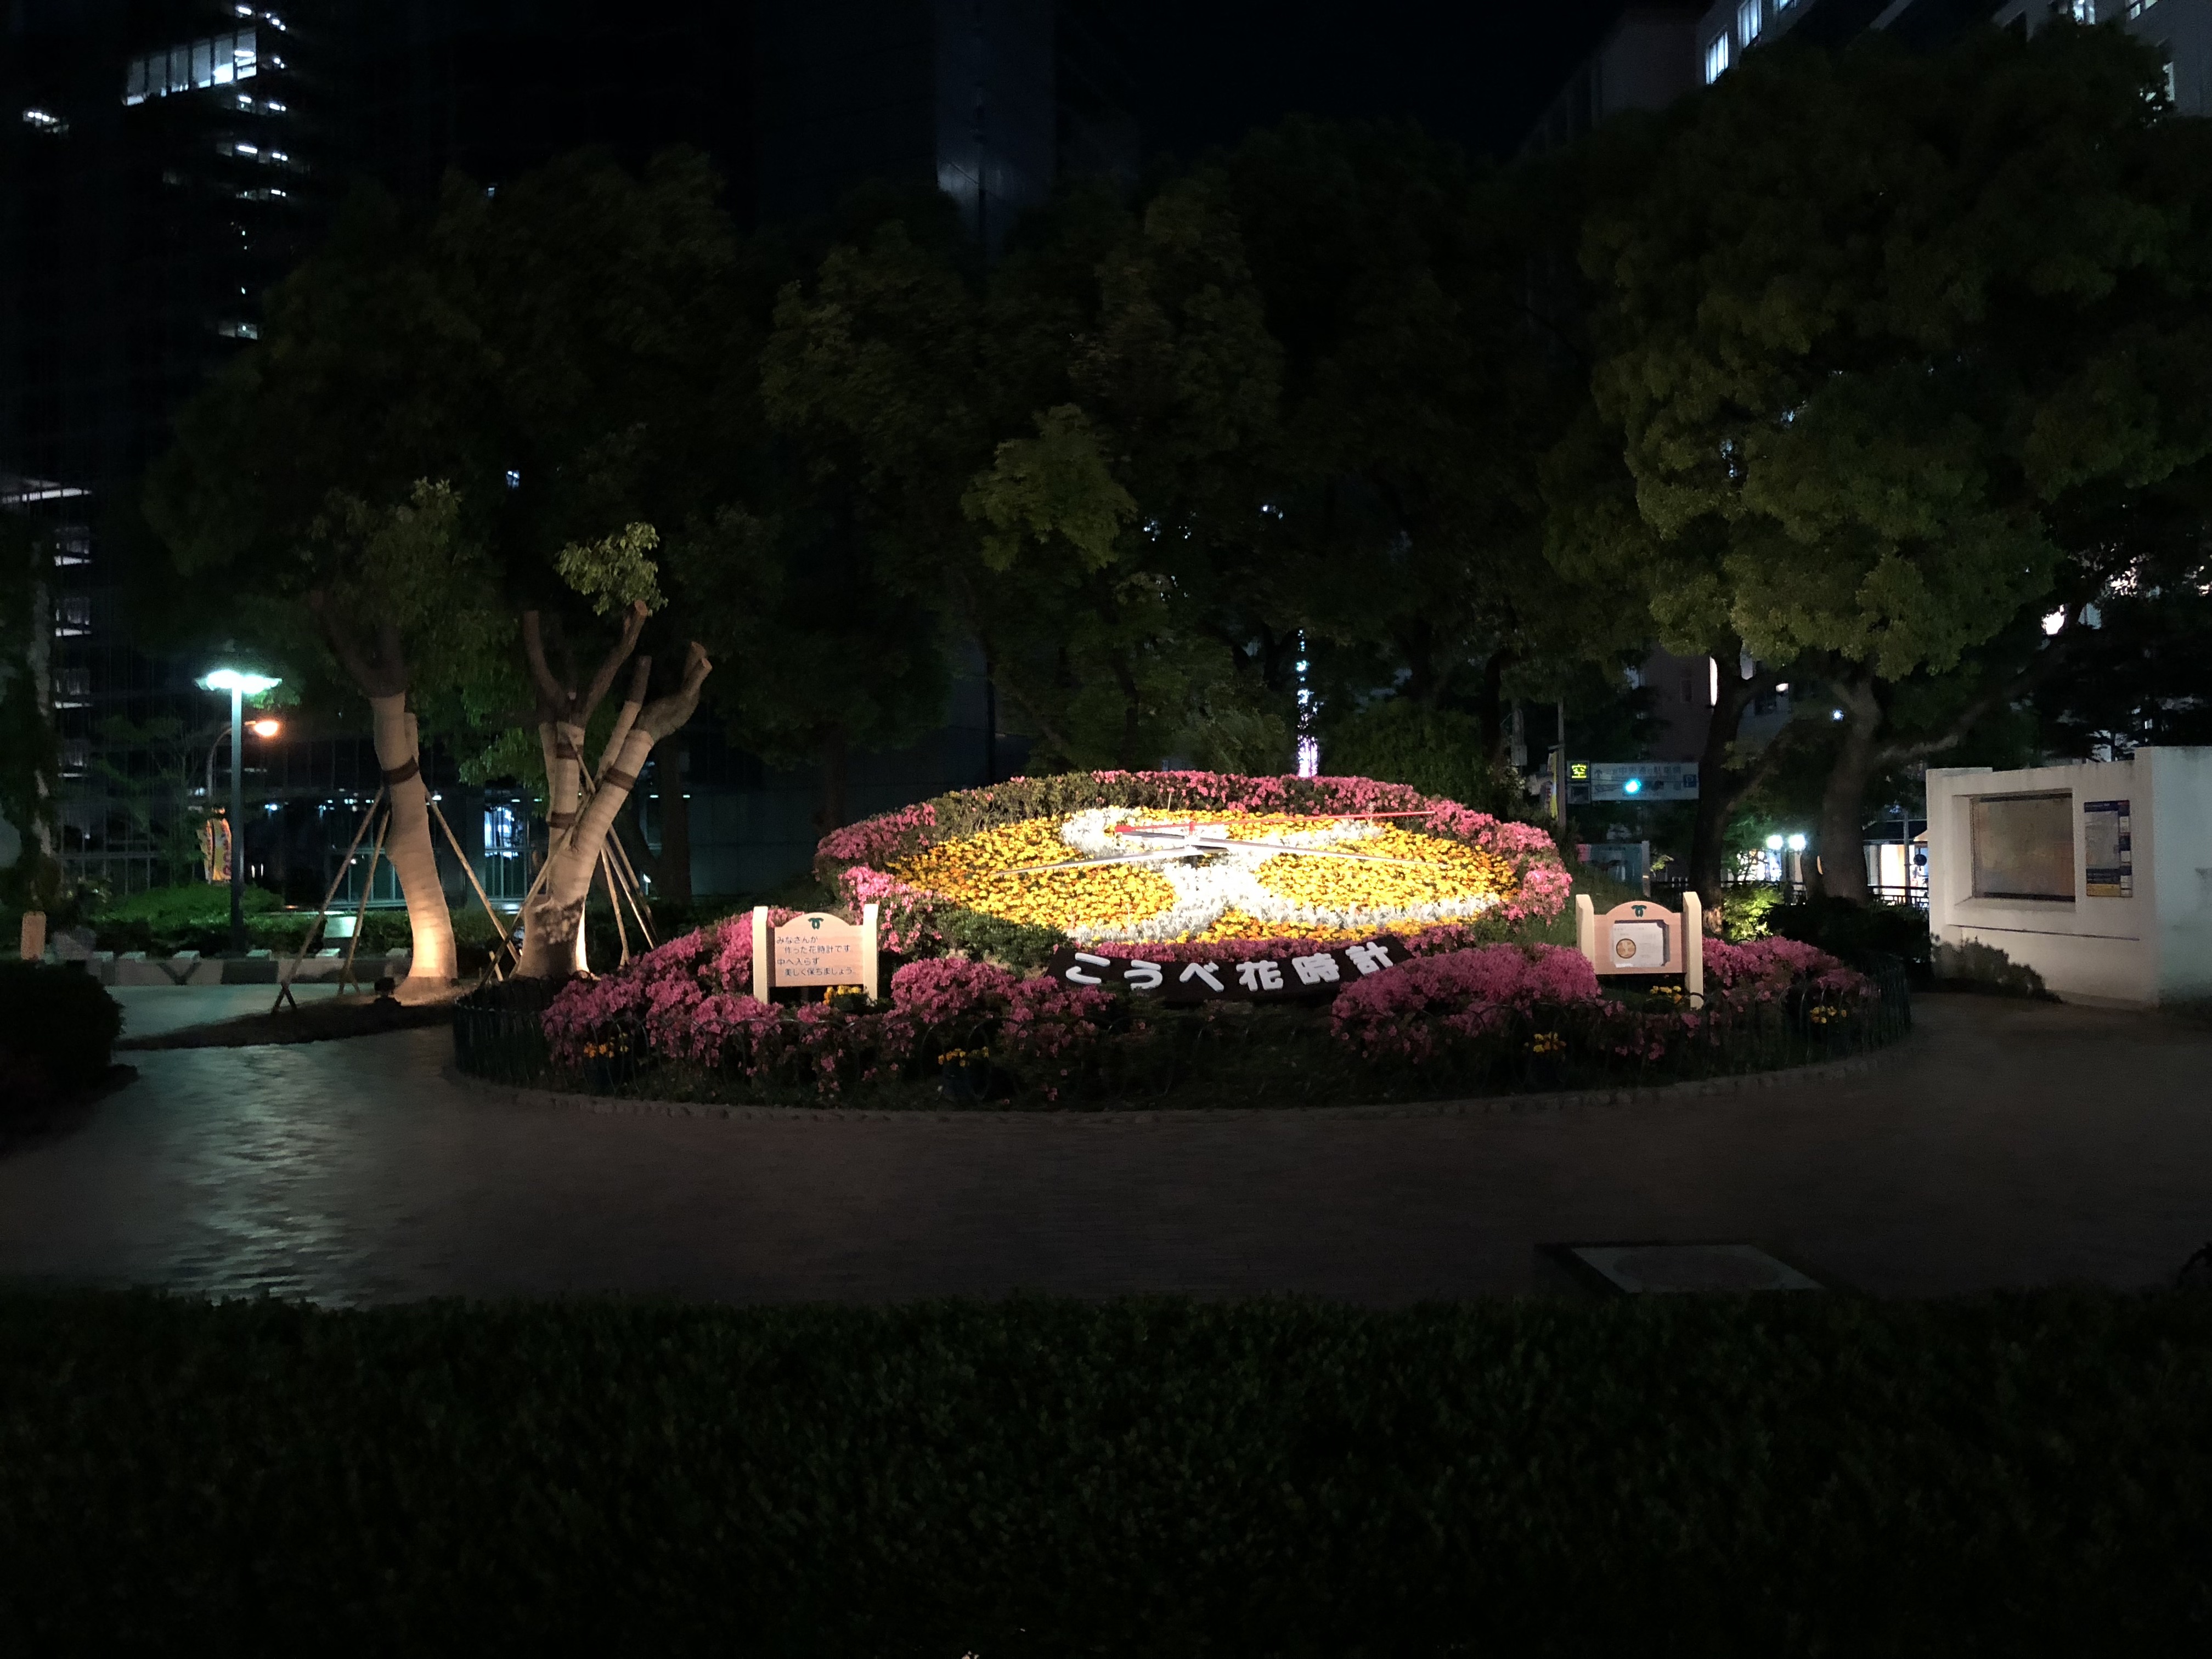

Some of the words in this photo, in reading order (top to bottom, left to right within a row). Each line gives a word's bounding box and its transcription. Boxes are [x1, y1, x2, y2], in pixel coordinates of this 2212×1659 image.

[776, 936, 818, 944] みなさんが
[777, 957, 820, 966] 中へ入らず
[1065, 941, 1394, 992] こうべ花時計
